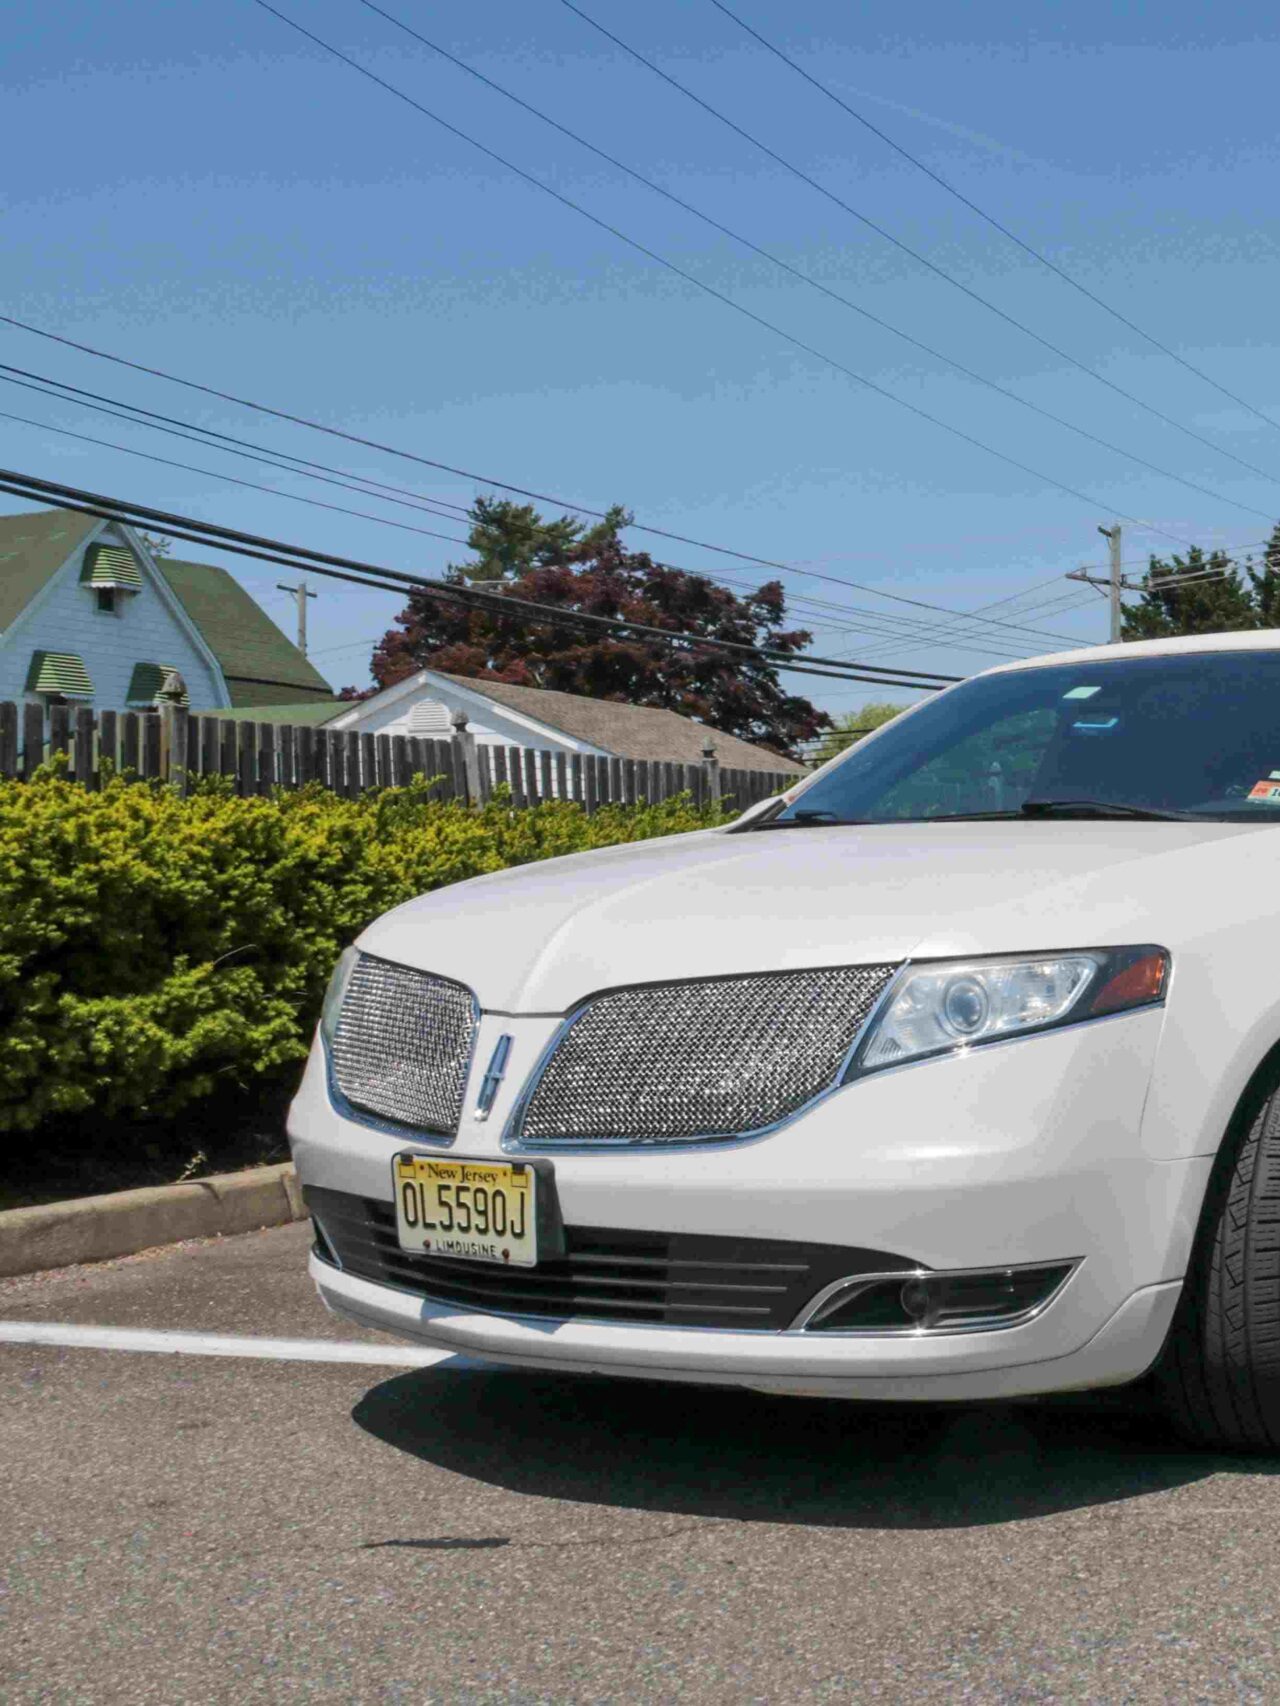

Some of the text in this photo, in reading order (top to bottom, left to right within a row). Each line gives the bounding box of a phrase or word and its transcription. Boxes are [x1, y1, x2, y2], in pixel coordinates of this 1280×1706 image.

[427, 1163, 498, 1186] New Jersey
[402, 1181, 526, 1240] OL5590J
[435, 1239, 497, 1259] LIMOUSINE
